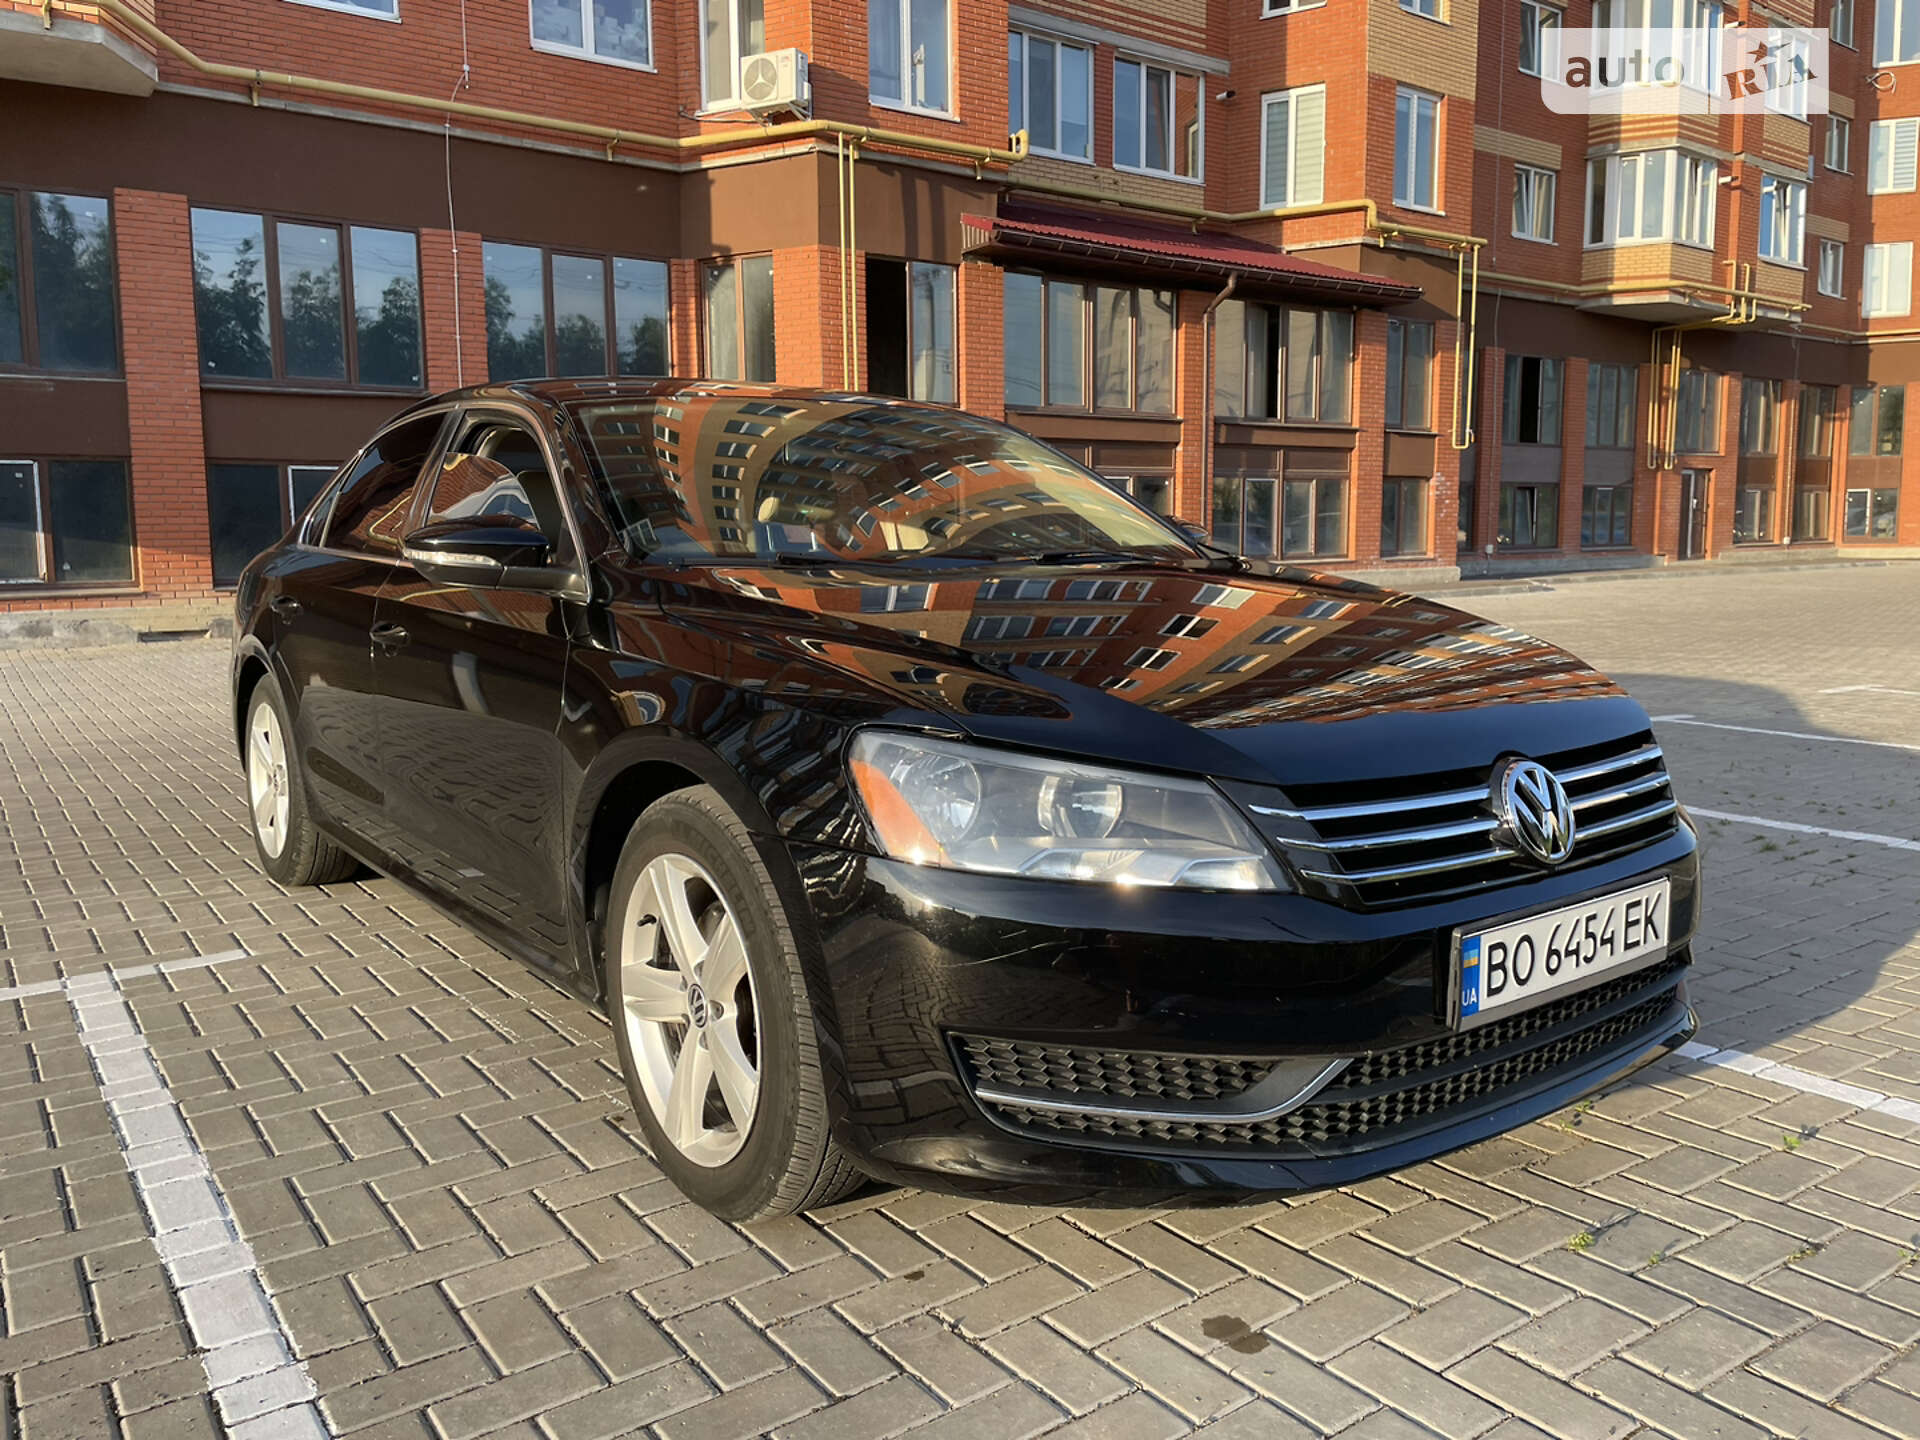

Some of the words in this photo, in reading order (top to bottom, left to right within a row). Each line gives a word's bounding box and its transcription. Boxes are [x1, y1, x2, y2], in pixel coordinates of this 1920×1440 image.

[1486, 934, 1535, 997] BO
[1545, 906, 1616, 976] 6454
[1623, 892, 1663, 950] EK
[1461, 987, 1478, 1006] UA
